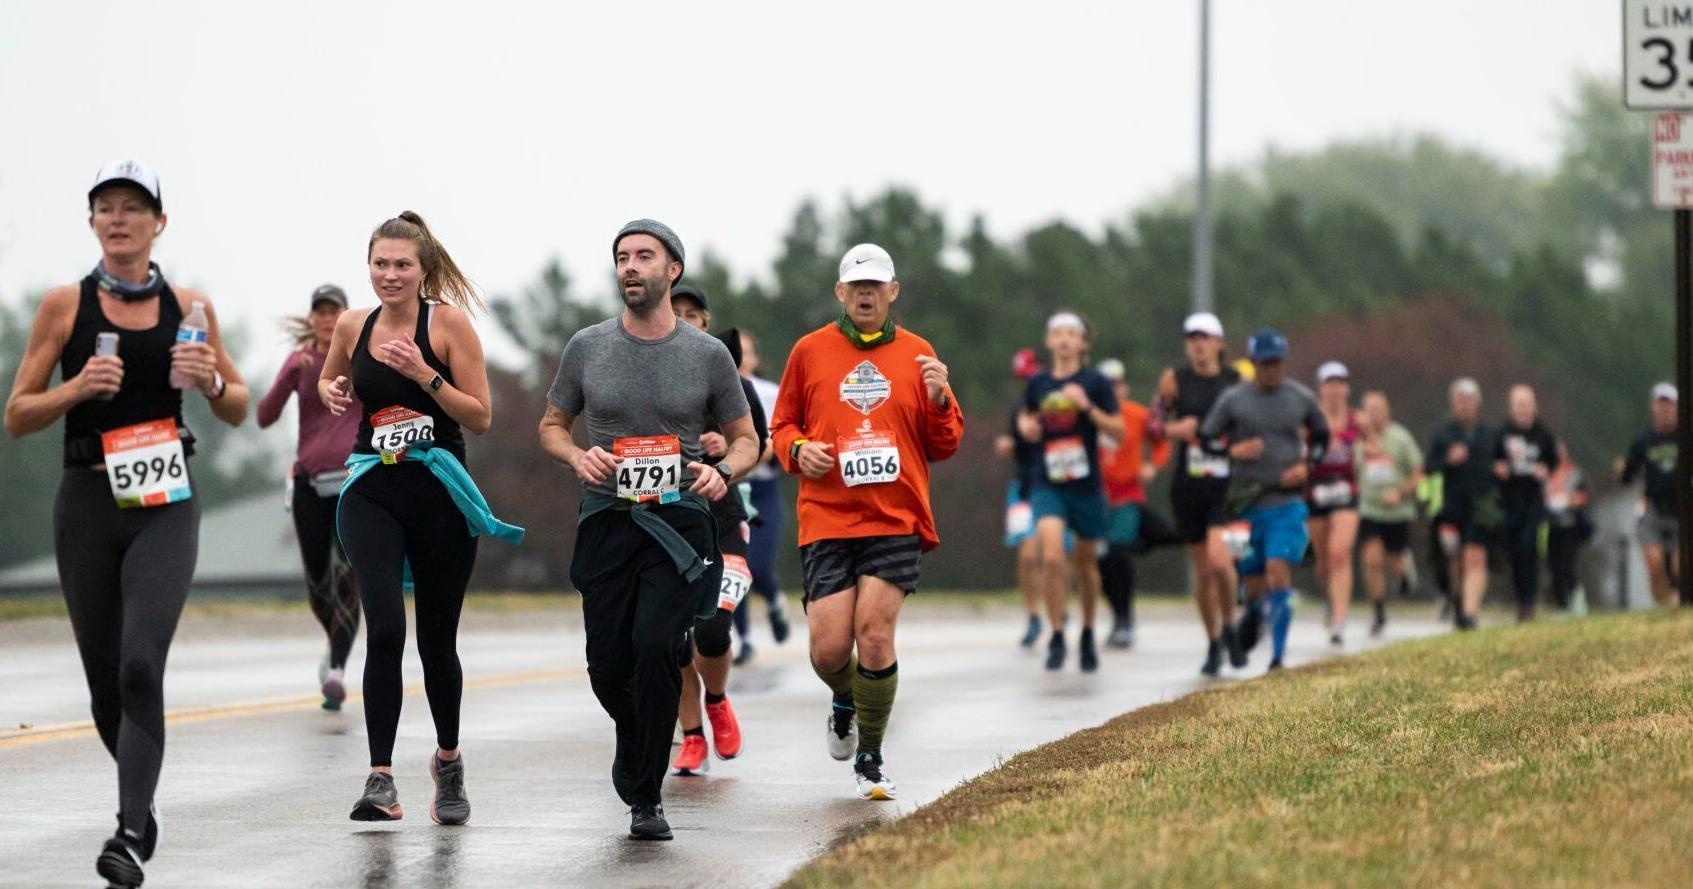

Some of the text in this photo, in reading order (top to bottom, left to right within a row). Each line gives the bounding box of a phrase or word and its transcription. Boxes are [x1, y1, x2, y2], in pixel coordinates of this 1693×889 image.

[1640, 38, 1693, 91] 3
[377, 425, 433, 449] 1500
[392, 421, 415, 430] Jenny
[113, 453, 182, 489] 5996
[635, 457, 660, 465] Dillon
[844, 456, 898, 478] 4056
[619, 463, 676, 489] 4791
[720, 577, 748, 599] 21
